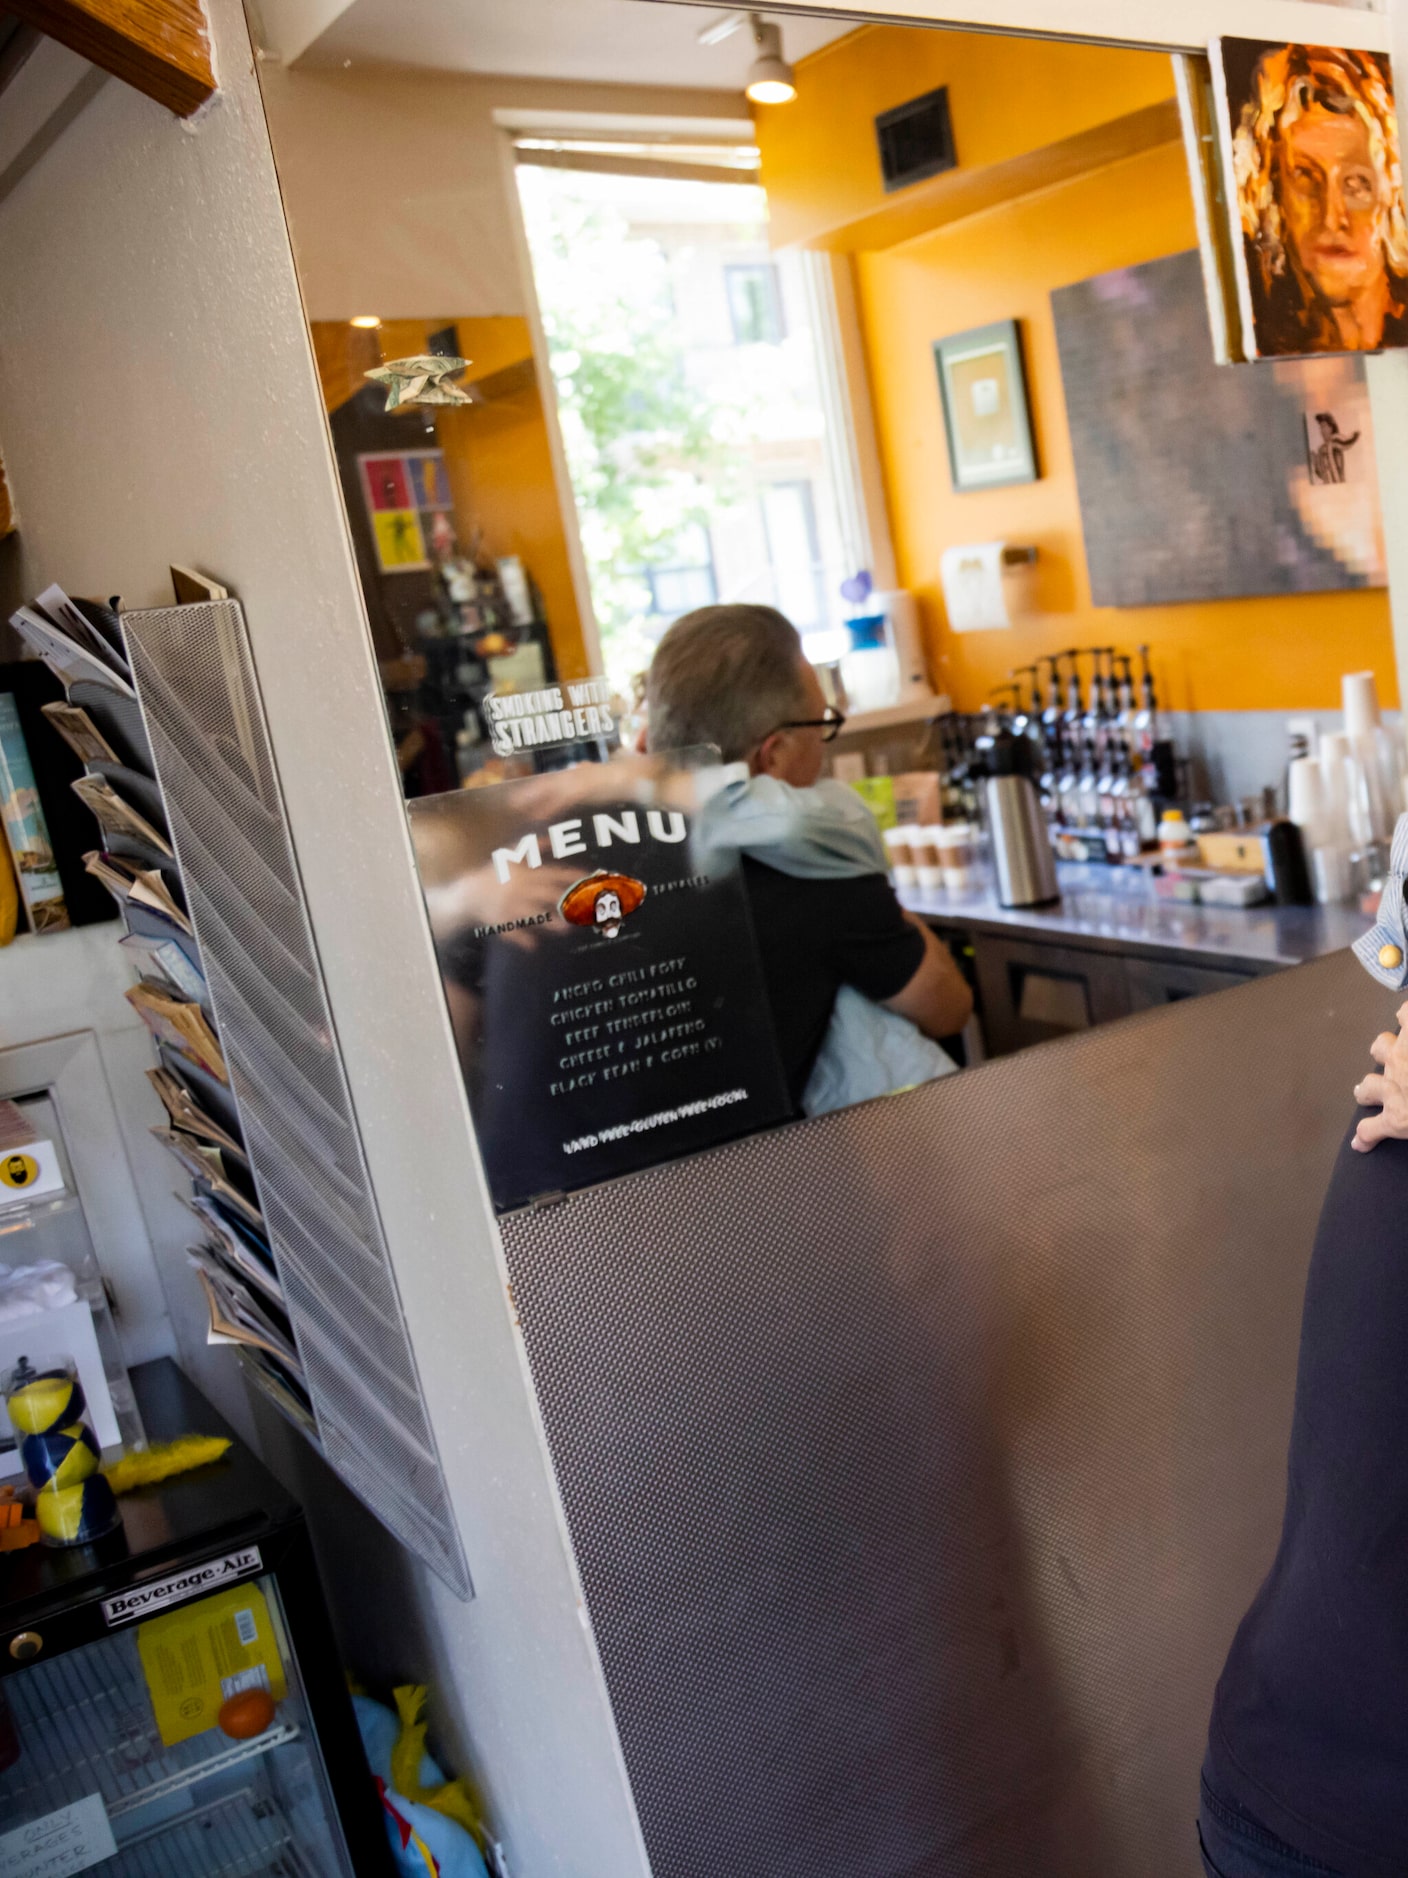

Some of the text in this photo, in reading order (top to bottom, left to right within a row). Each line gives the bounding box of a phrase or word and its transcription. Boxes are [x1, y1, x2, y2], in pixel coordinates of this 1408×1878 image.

[489, 687, 564, 720] SMOKING
[494, 704, 614, 755] STRANGERS
[491, 810, 687, 885] MENU
[473, 911, 553, 938] HANDMADE
[550, 977, 698, 1026] CHICKEN TOMATILLO
[553, 979, 604, 1003] ANCHO
[565, 1000, 692, 1046] BEEF TENDERLOIN
[550, 1071, 597, 1096] BLACK
[603, 1059, 640, 1081] BEAN
[661, 1042, 700, 1063] CORN
[559, 1045, 611, 1070] CHEESE
